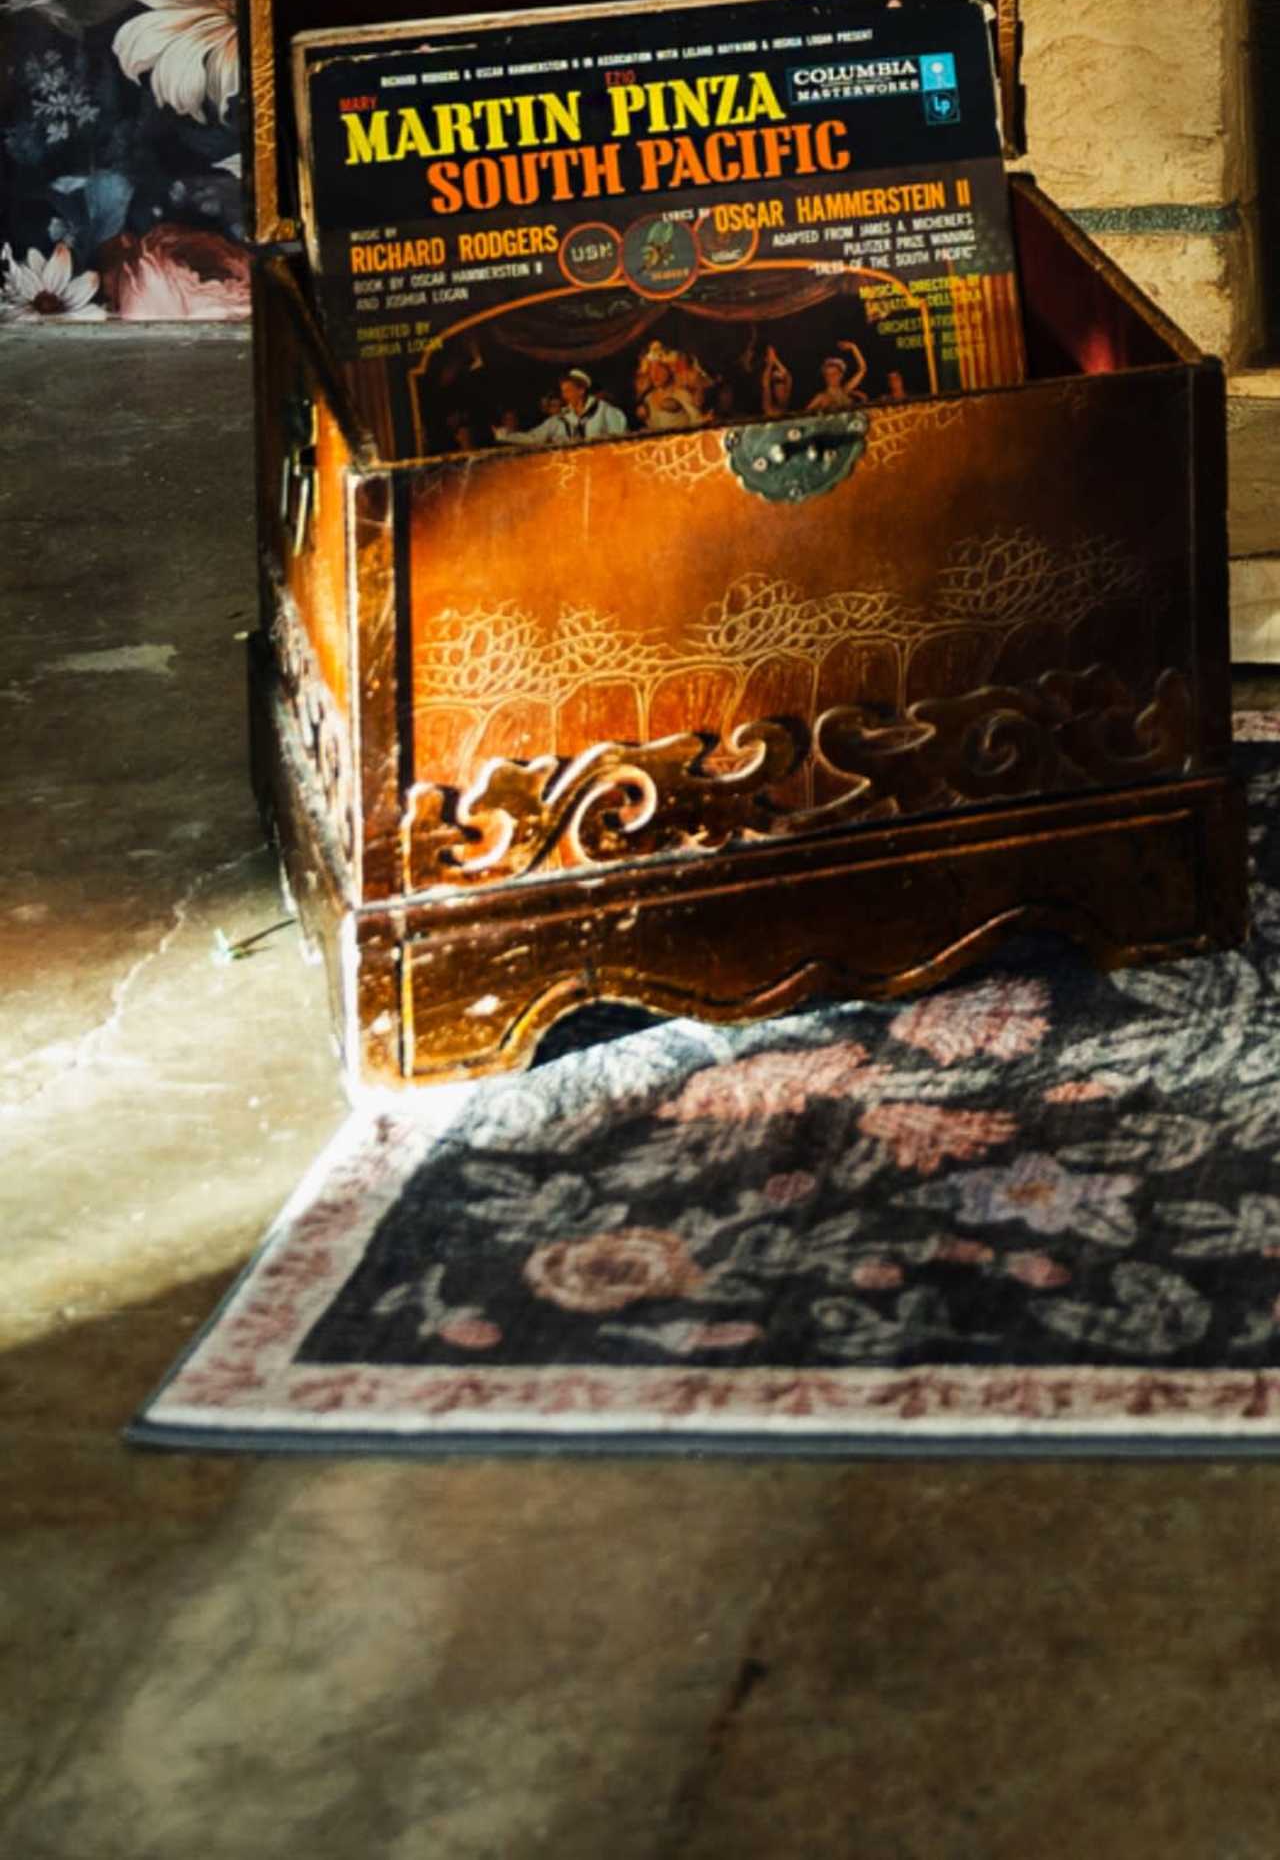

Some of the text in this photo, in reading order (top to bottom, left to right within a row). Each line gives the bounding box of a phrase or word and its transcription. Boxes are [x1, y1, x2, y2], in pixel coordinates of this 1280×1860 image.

[476, 66, 504, 79] OSCAR
[598, 52, 651, 67] ASSOCIATION
[657, 48, 678, 60] WITH
[837, 29, 873, 42] PRESENT
[604, 69, 636, 85] EZIO
[793, 59, 917, 86] COLUMBIA
[796, 79, 920, 102] MASTERWORKS
[339, 94, 378, 112] MARY
[340, 71, 787, 166] MARTIN PINZA
[426, 119, 850, 214] SOUTH PACIFIC
[662, 209, 694, 222] LYRICS
[714, 178, 971, 234] OSCAR HAMMERSTEIN II
[384, 227, 397, 239] BY
[772, 230, 820, 248] ADAPTED
[824, 225, 854, 241] FROM
[859, 221, 892, 237] JAMES
[896, 235, 925, 249] PRIZE
[930, 229, 976, 245] WINNING
[351, 224, 559, 274] RICHARD RODGERS
[571, 243, 613, 263] USN
[870, 254, 891, 269] THE
[896, 250, 929, 267] SOUTH
[353, 279, 384, 295] BOOK
[389, 277, 404, 290] BY
[410, 271, 446, 288] OSCAR
[452, 263, 530, 283] HAMMERSTEIN
[356, 287, 469, 311] AND JOSHUA LOGAN
[356, 321, 432, 342] DIRECTED BY
[360, 343, 401, 359] JOSHUA
